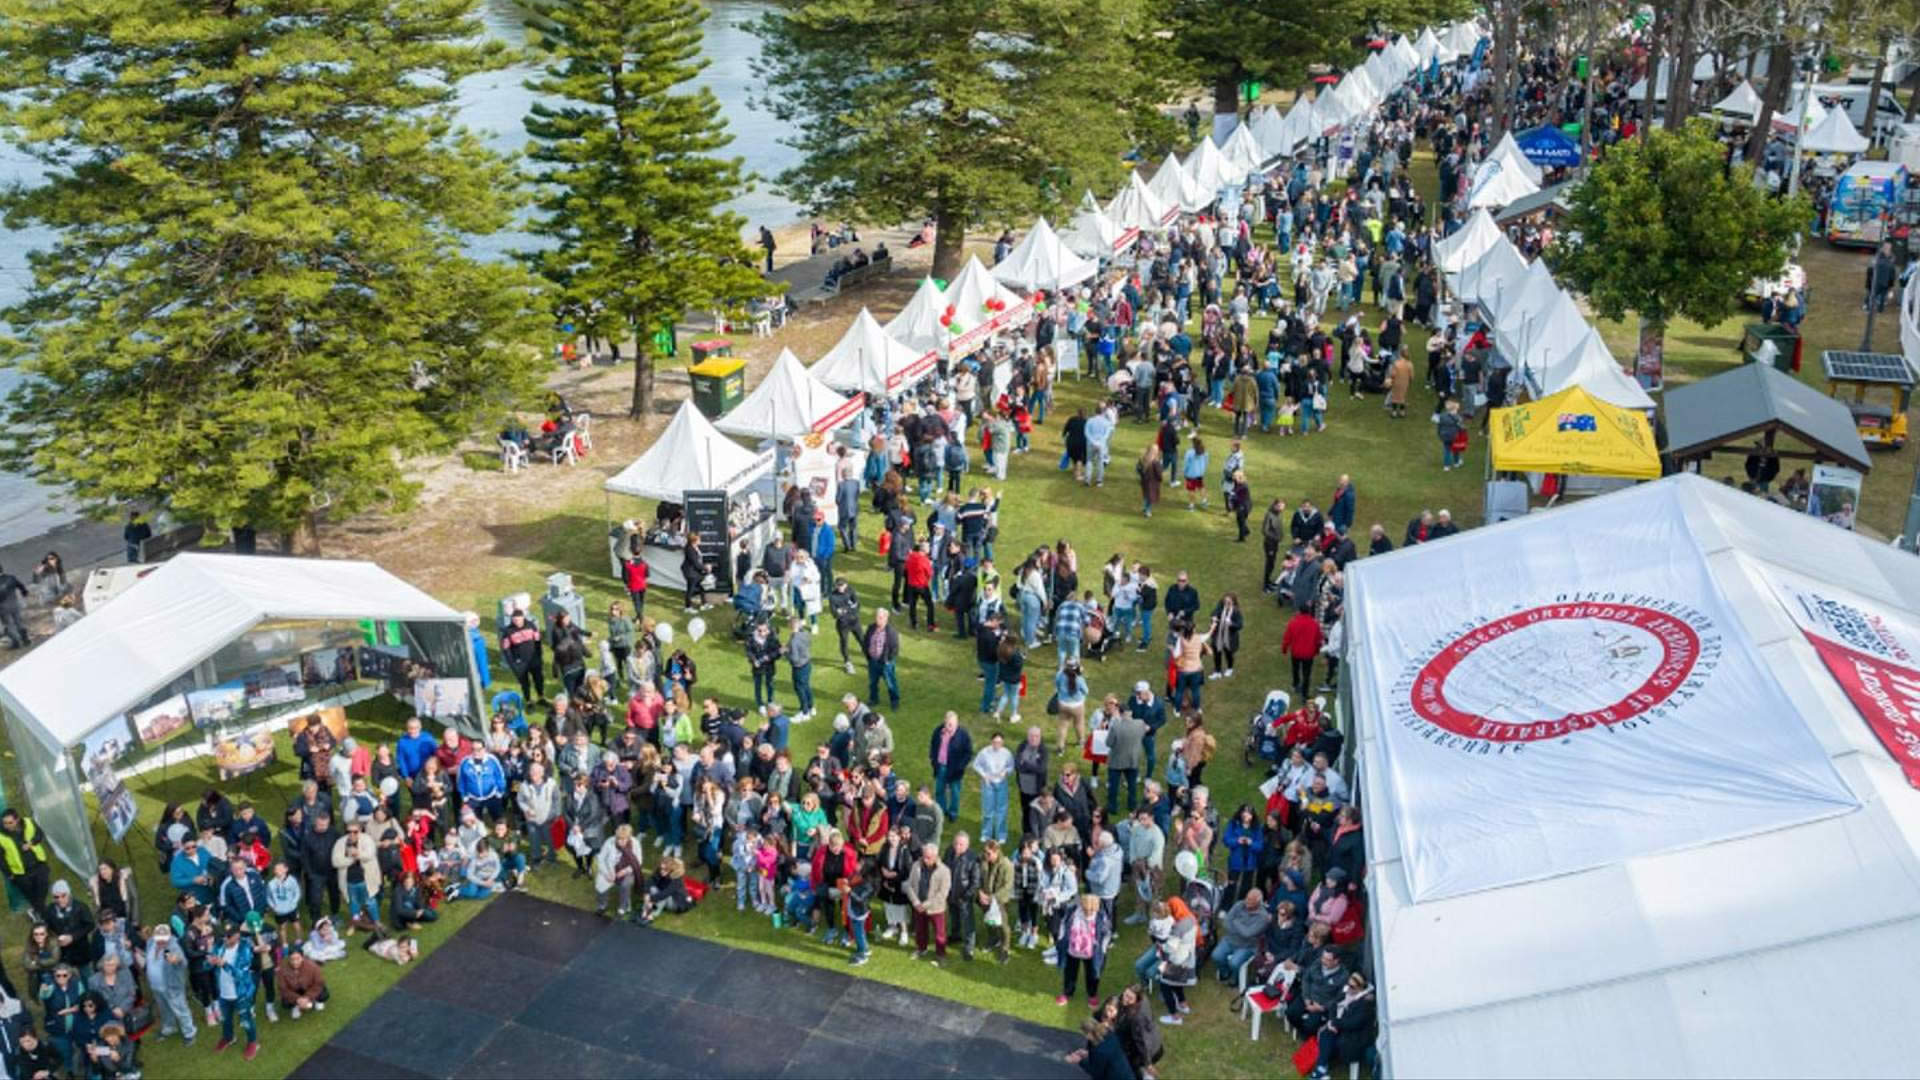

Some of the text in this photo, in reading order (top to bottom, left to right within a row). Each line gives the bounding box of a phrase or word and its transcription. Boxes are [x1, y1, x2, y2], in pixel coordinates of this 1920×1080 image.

[1527, 606, 1644, 624] ORTHODOX
[1453, 621, 1518, 657] GREEK
[1478, 711, 1618, 738] AUSTRALIA
